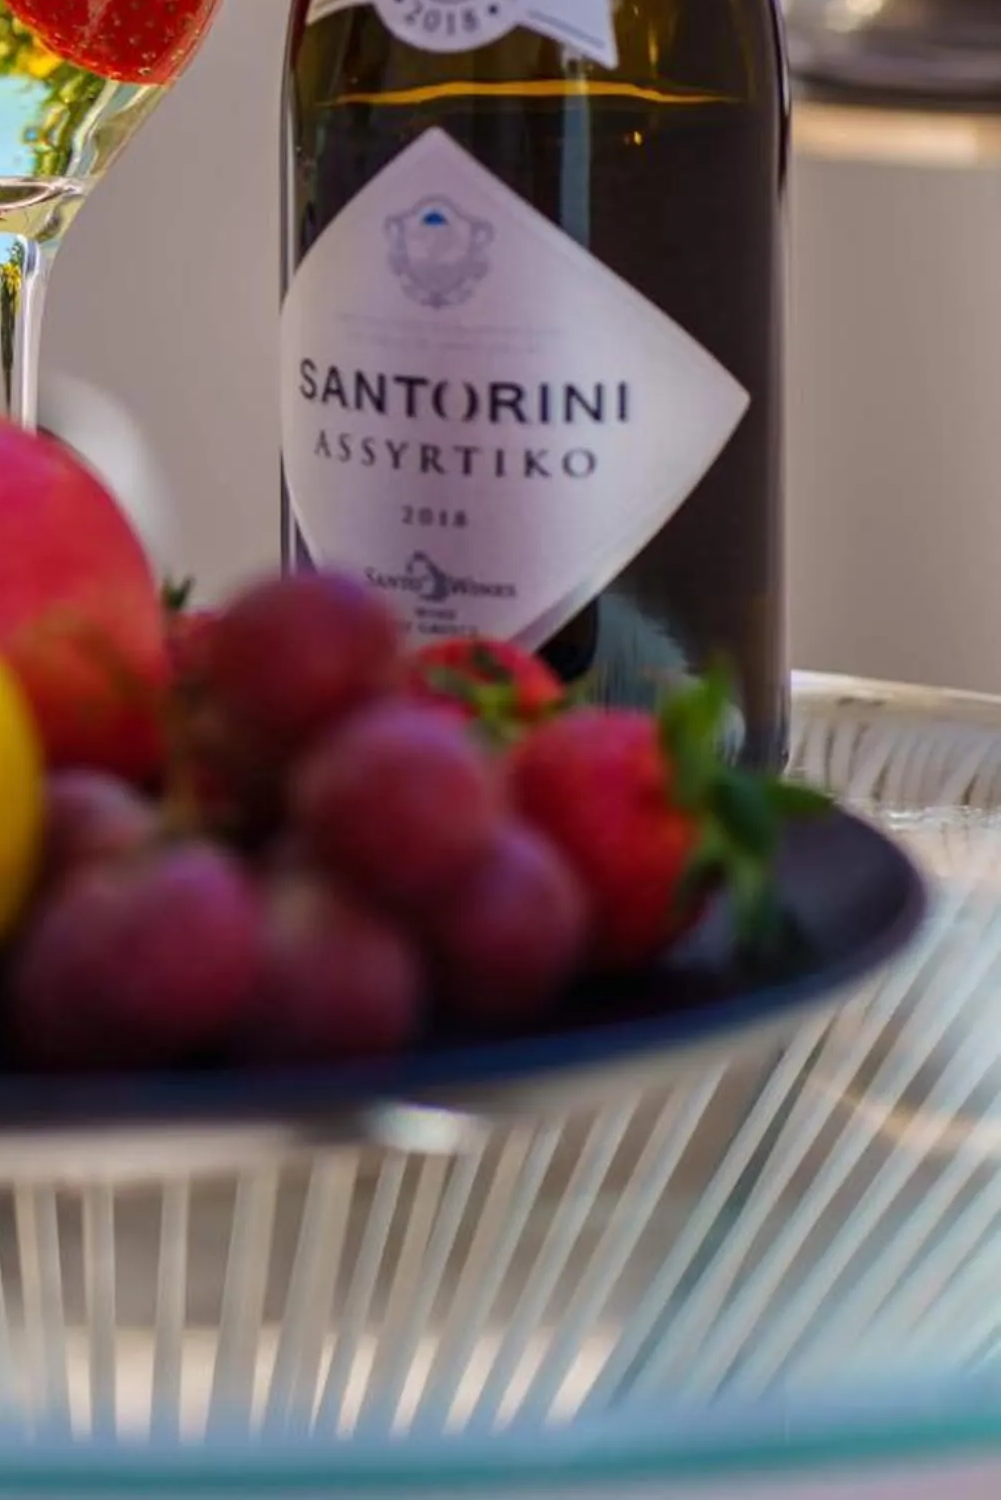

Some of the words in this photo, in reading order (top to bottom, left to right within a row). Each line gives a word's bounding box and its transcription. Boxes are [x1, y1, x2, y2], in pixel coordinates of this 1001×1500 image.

[404, 0, 479, 36] 2018
[298, 357, 629, 424] SANTORINI
[314, 429, 597, 478] ASSYRTIKO
